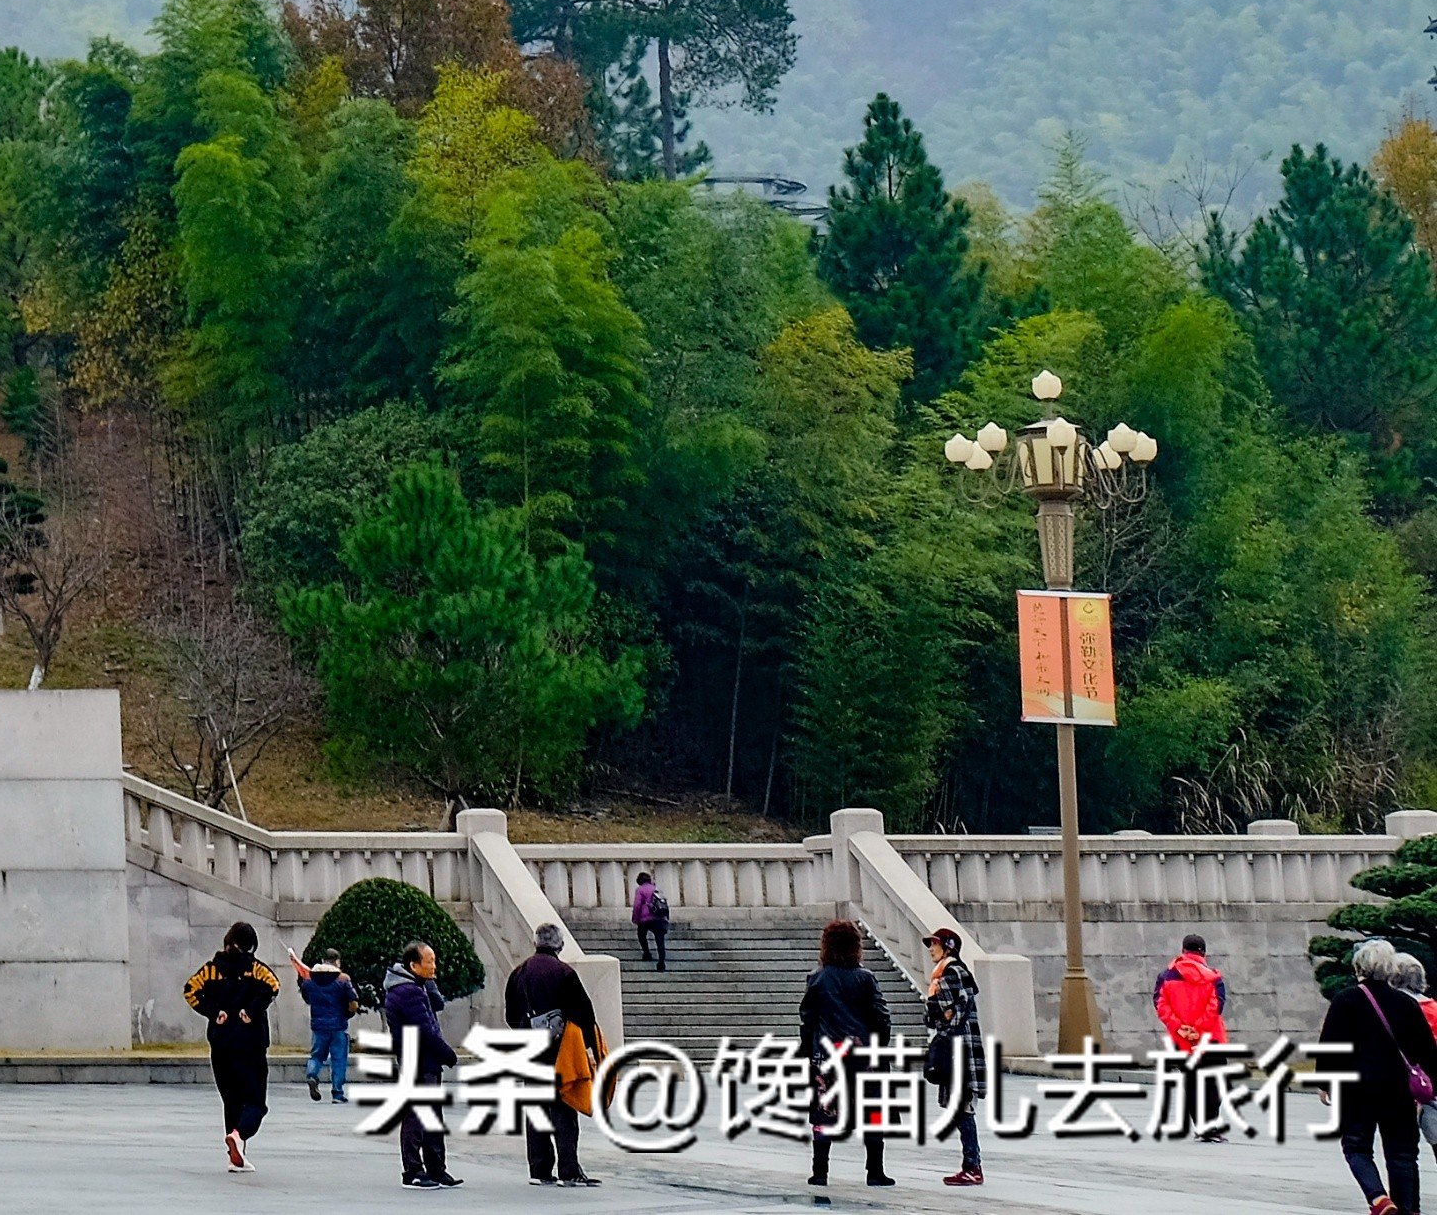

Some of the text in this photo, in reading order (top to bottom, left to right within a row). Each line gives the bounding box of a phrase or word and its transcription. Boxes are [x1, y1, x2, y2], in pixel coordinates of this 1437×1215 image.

[1079, 632, 1099, 699] 弥勒文化节
